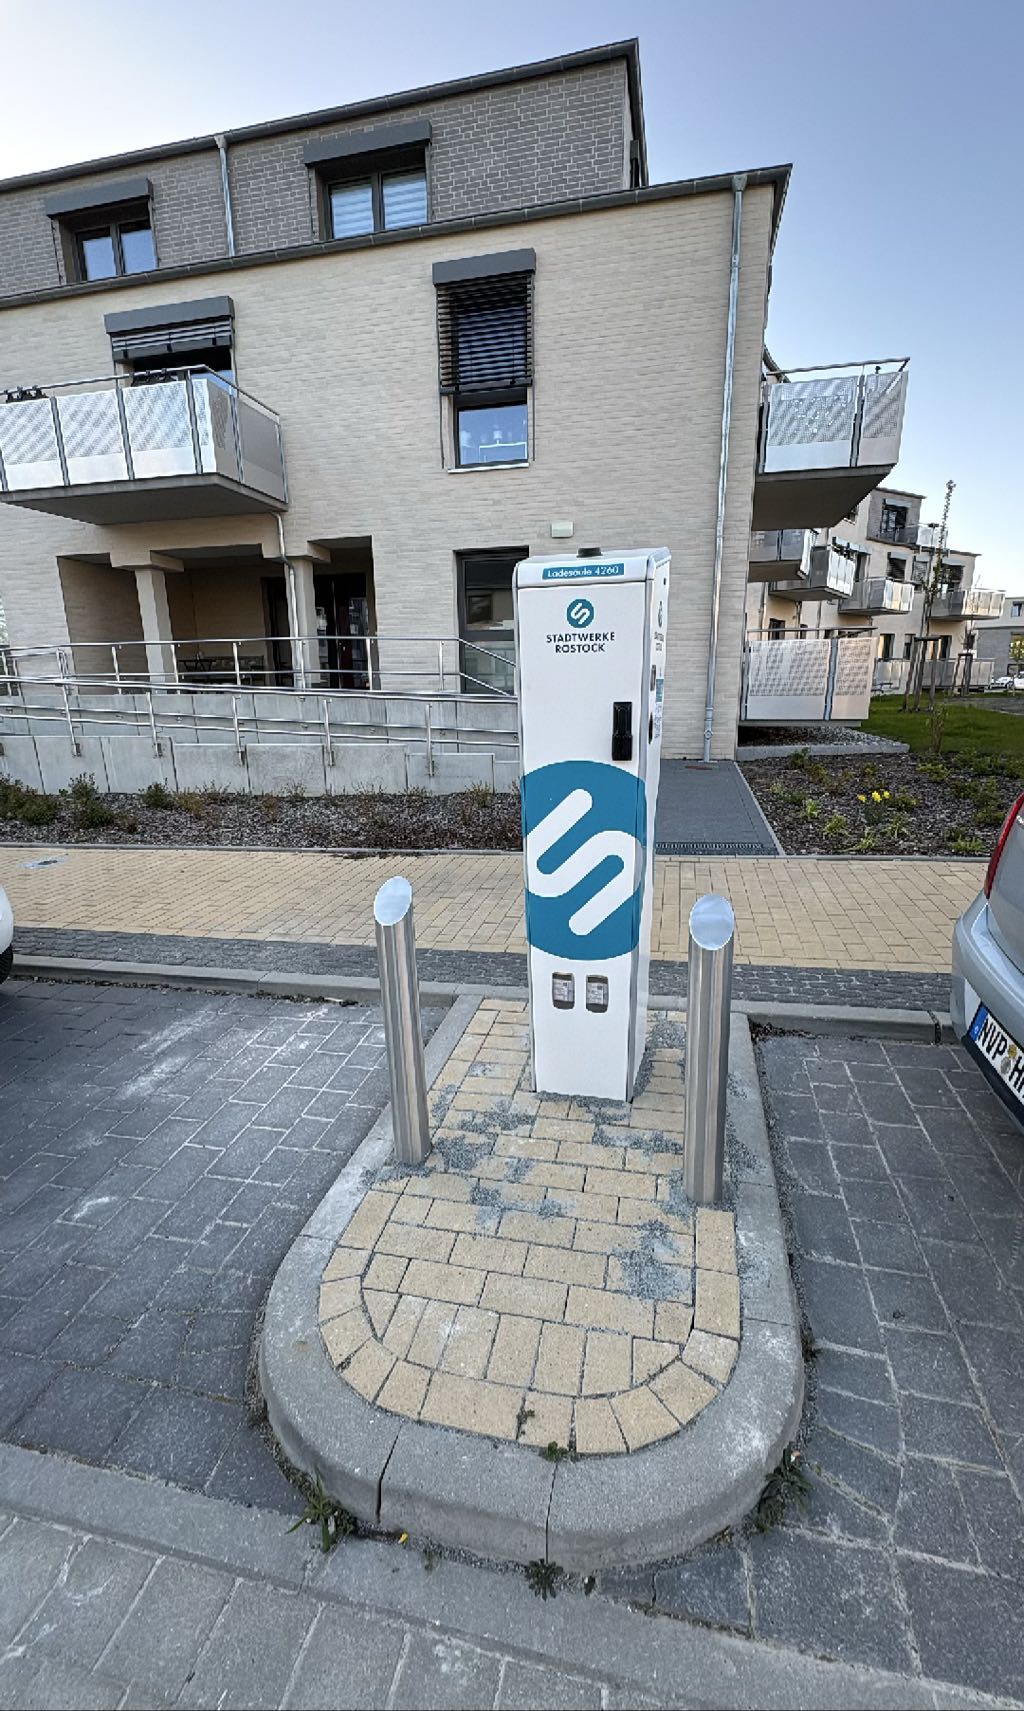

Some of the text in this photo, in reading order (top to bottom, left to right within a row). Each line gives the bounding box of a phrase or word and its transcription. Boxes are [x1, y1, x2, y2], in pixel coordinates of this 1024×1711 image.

[594, 565, 619, 576] 4260
[546, 631, 615, 643] STADTWERKE
[555, 642, 606, 653] ROSTOCK
[978, 1018, 1008, 1060] NVP
